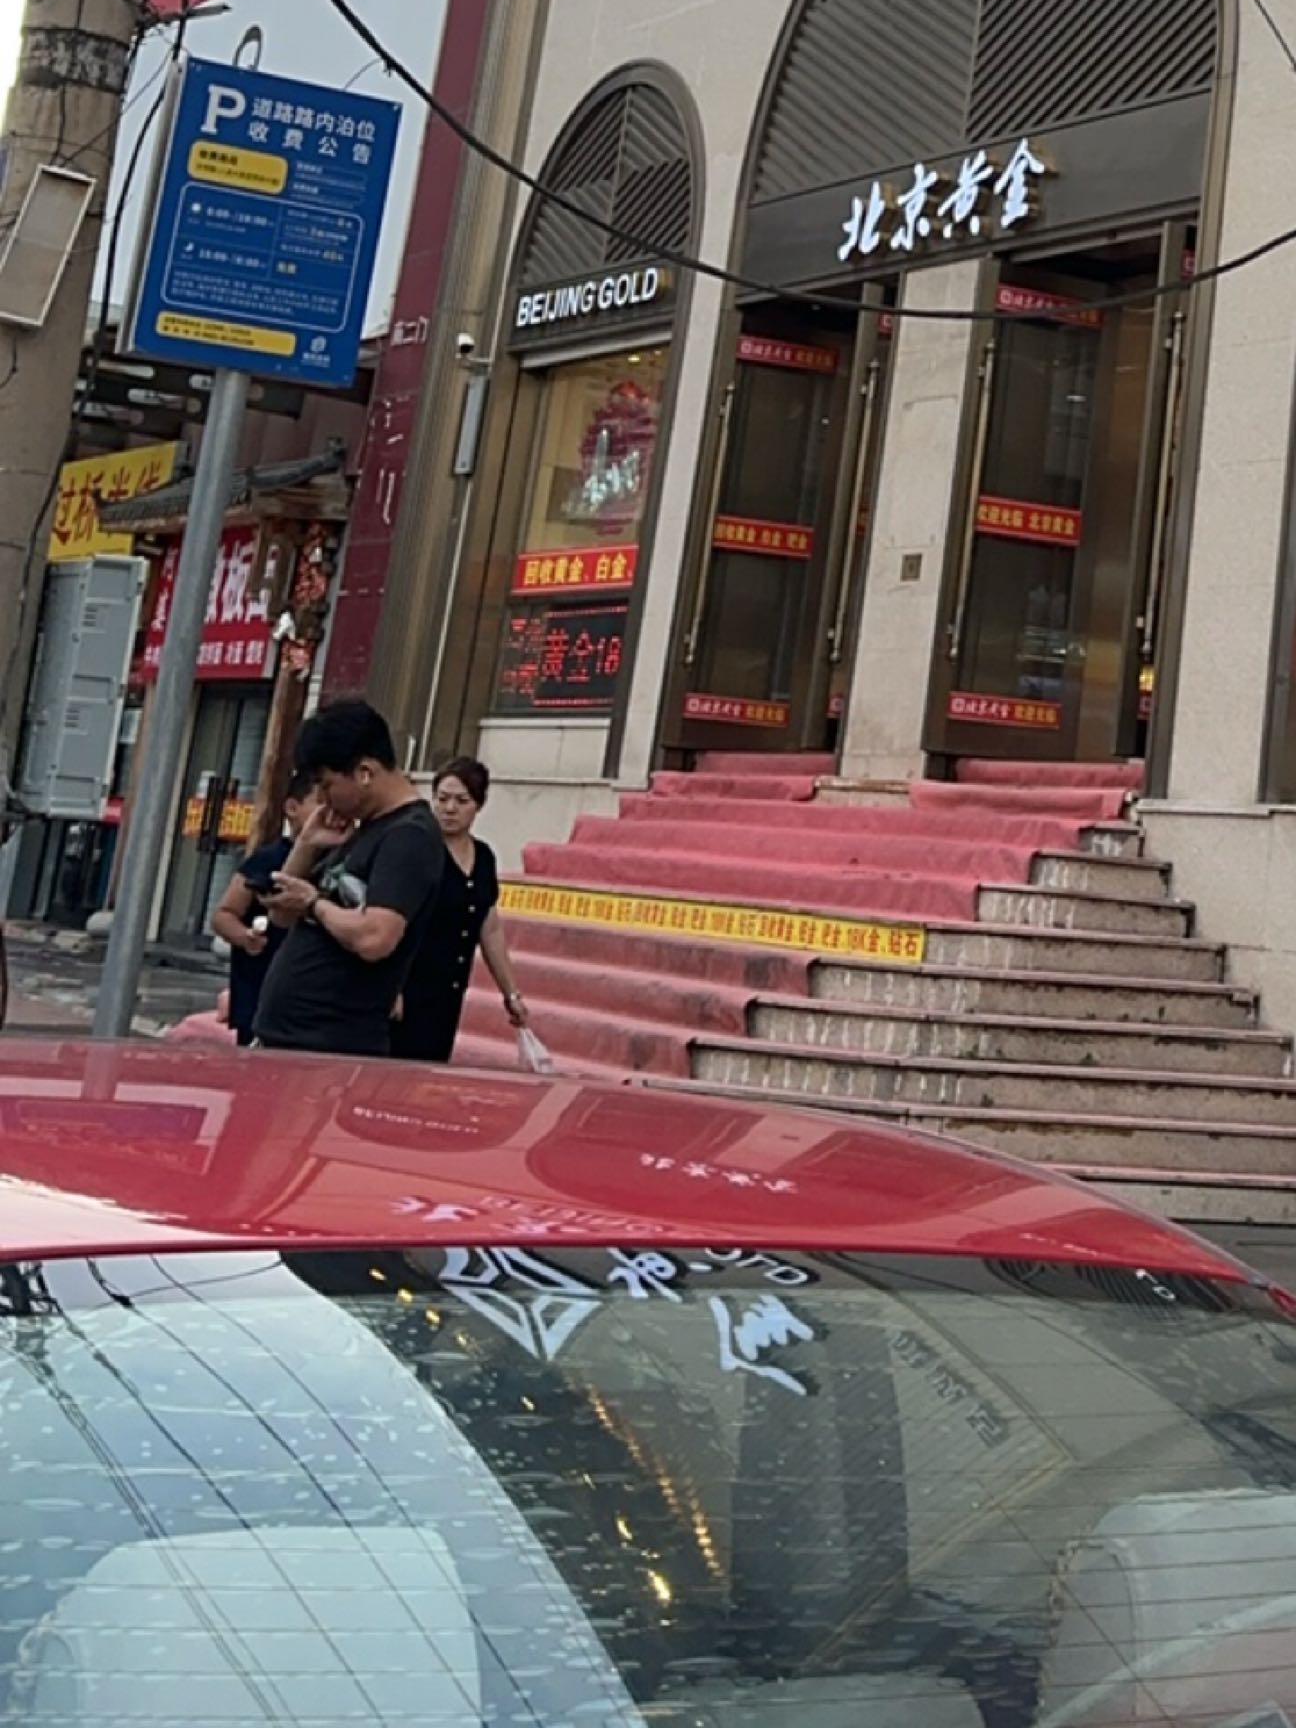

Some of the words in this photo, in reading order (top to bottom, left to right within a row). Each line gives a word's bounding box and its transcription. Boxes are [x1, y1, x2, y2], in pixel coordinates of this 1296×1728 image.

[200, 83, 247, 135] P
[251, 96, 376, 142] 道路路内泊位
[248, 121, 373, 165] 收费公告
[837, 138, 1045, 261] 北京黄金
[516, 281, 596, 327] BEIJING
[600, 267, 658, 309] GOLD
